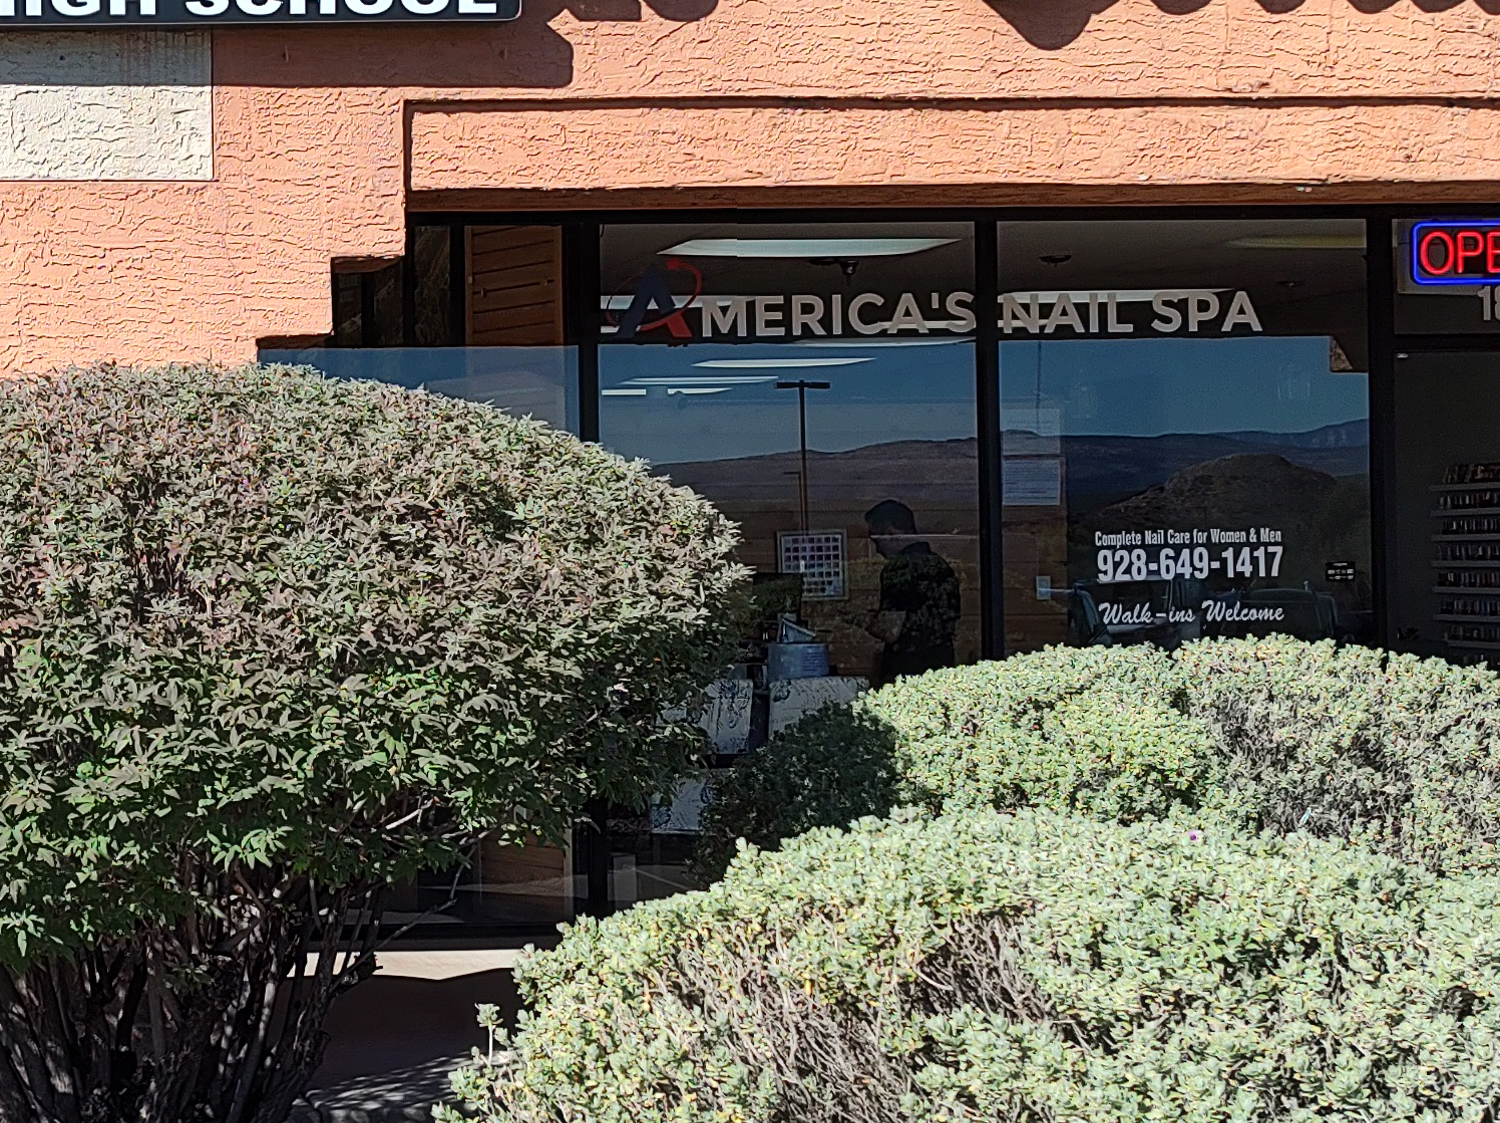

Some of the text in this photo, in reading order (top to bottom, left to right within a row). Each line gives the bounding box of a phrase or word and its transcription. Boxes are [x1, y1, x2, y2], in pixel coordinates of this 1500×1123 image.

[1002, 292, 1134, 334] NAIL
[1151, 290, 1263, 333] SPA
[1095, 527, 1282, 548] Complete Nail Care for Women & Men
[1097, 545, 1284, 582] 928-649-1417
[1201, 599, 1285, 622] Welcome
